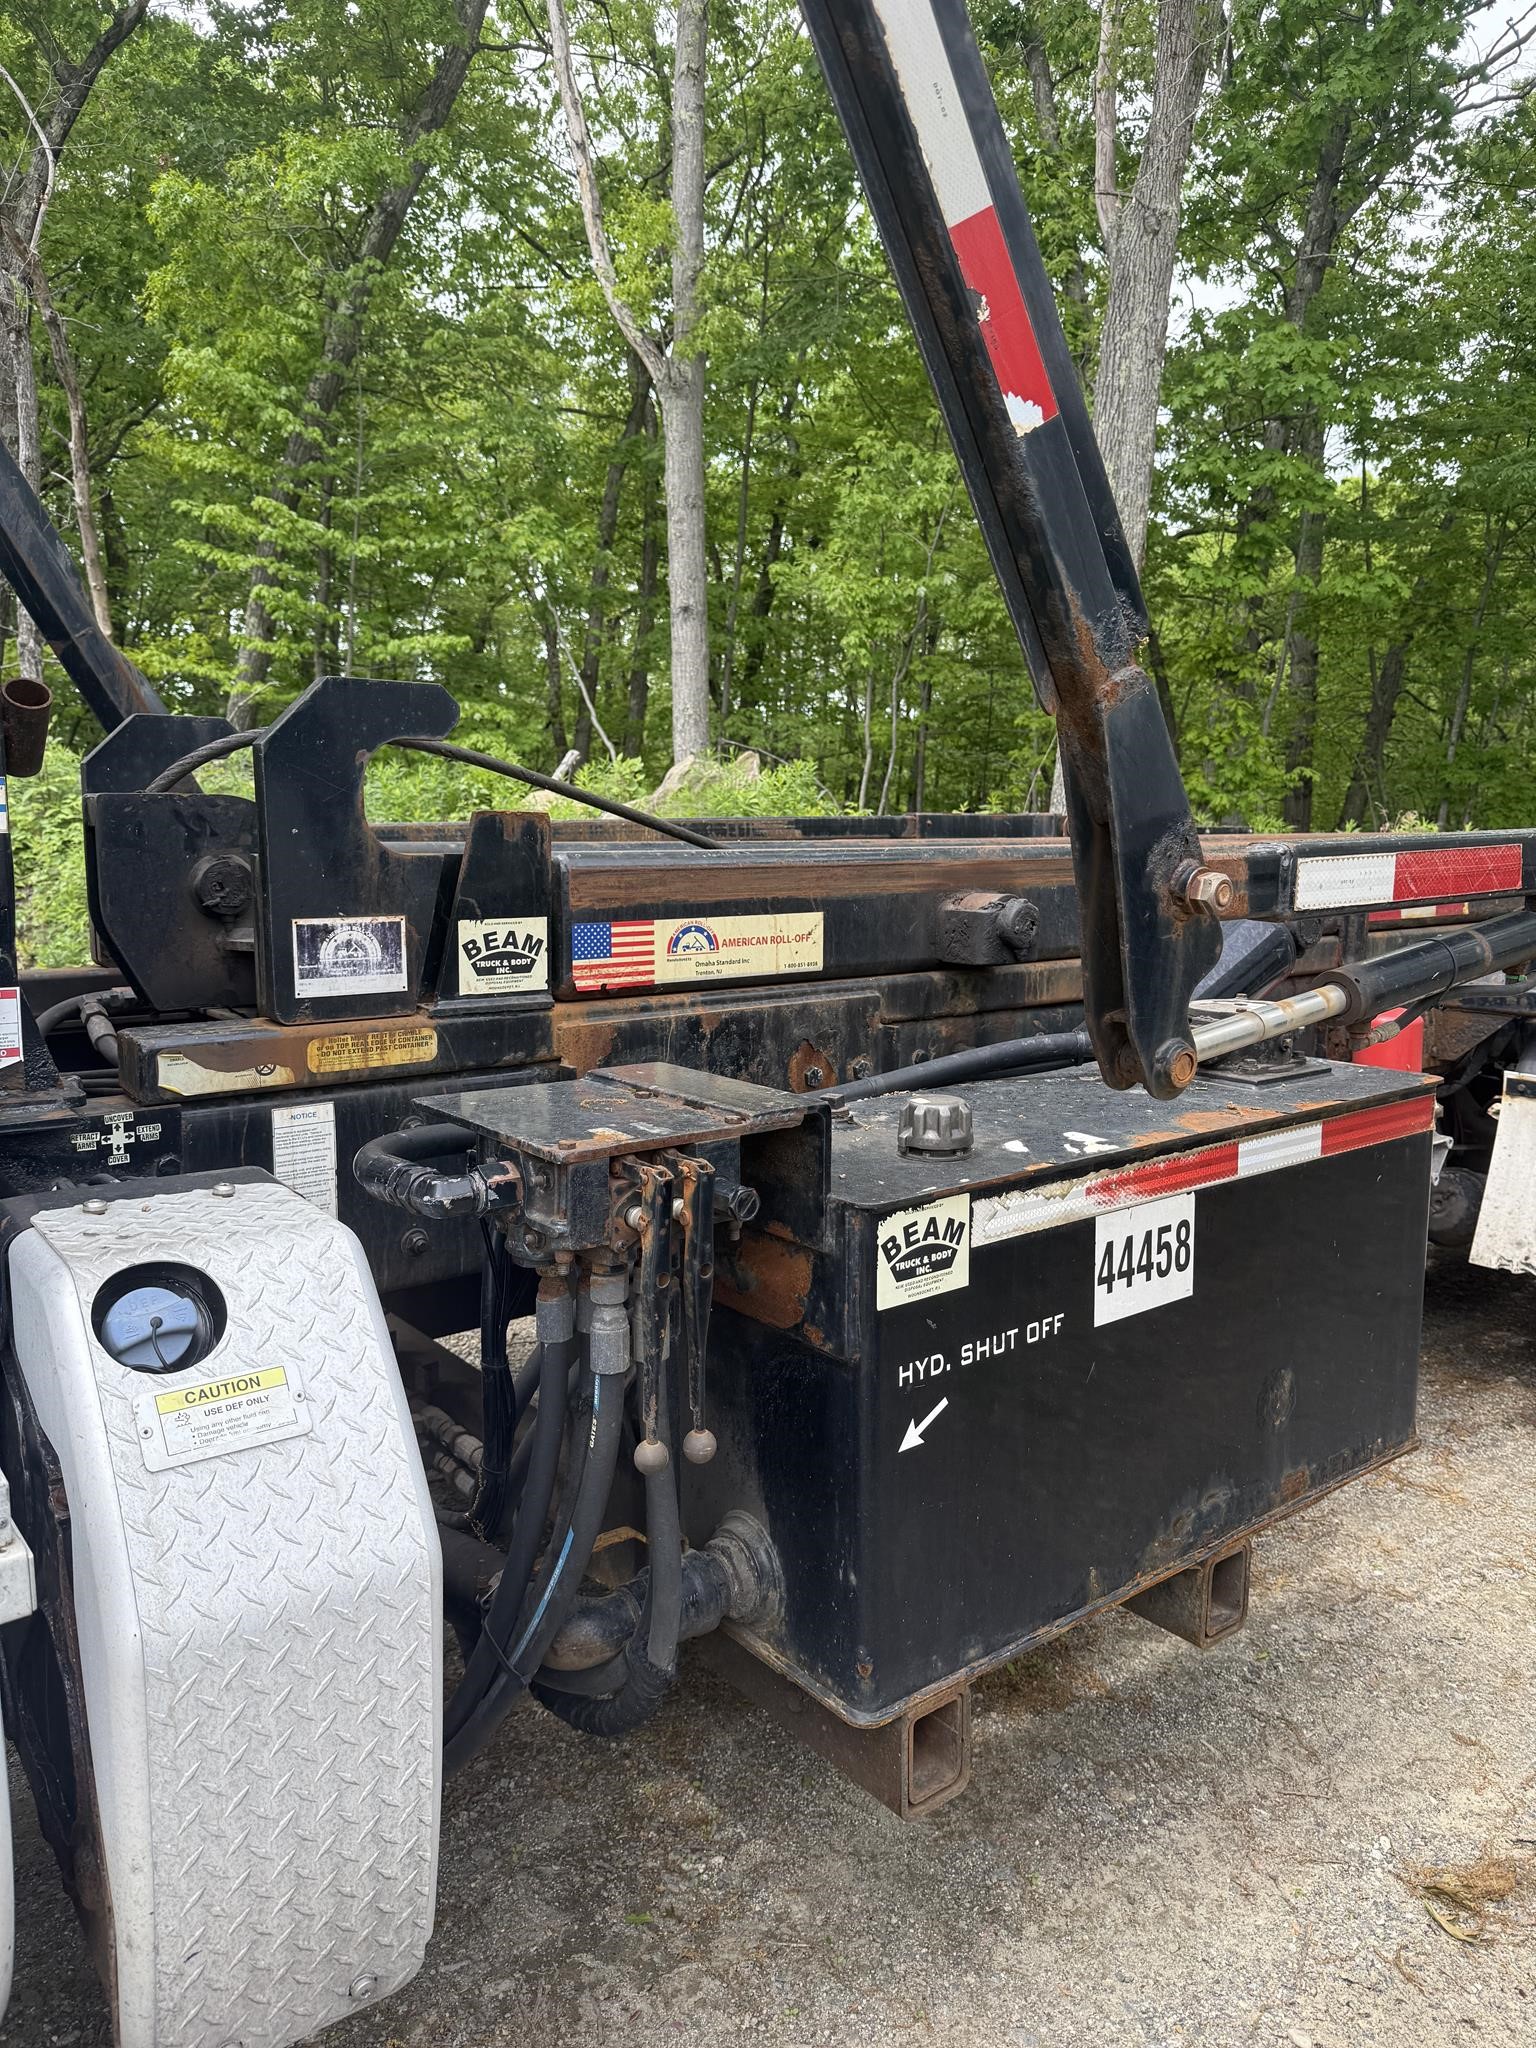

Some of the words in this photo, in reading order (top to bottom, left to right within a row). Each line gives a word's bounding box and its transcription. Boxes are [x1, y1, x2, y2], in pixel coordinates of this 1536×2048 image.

[462, 930, 544, 961] BEAM
[721, 936, 768, 948] AMERICAN
[770, 933, 811, 945] ROLL-OFF
[476, 959, 501, 967] TRUCK
[716, 958, 741, 966] Standard
[398, 1035, 433, 1043] CONTAINER
[393, 1041, 429, 1050] CONTAINER
[104, 1113, 133, 1123] UNCOVER
[291, 1112, 317, 1121] NOTICE
[137, 1125, 160, 1134] EXTEND
[70, 1133, 99, 1142] RETRACT
[77, 1142, 96, 1150] ARMS
[108, 1155, 129, 1164] COVER
[881, 1217, 966, 1265] BEAM
[895, 1258, 921, 1271] TRUCK
[931, 1249, 953, 1262] BODY
[1097, 1219, 1191, 1294] 44458
[916, 1265, 932, 1275] INC.
[898, 1352, 951, 1387] HYD.
[960, 1327, 1019, 1367] SHUT
[1026, 1312, 1065, 1344] OFF
[184, 1376, 261, 1404] CAUTION
[204, 1407, 224, 1417] USE
[225, 1401, 243, 1411] DEF
[246, 1394, 270, 1406] ONLY
[190, 1423, 210, 1433] Using
[211, 1421, 224, 1429] any
[224, 1416, 241, 1424] other
[197, 1427, 225, 1439] Damage
[226, 1421, 249, 1431] vehicle
[589, 1418, 598, 1449] GATES
